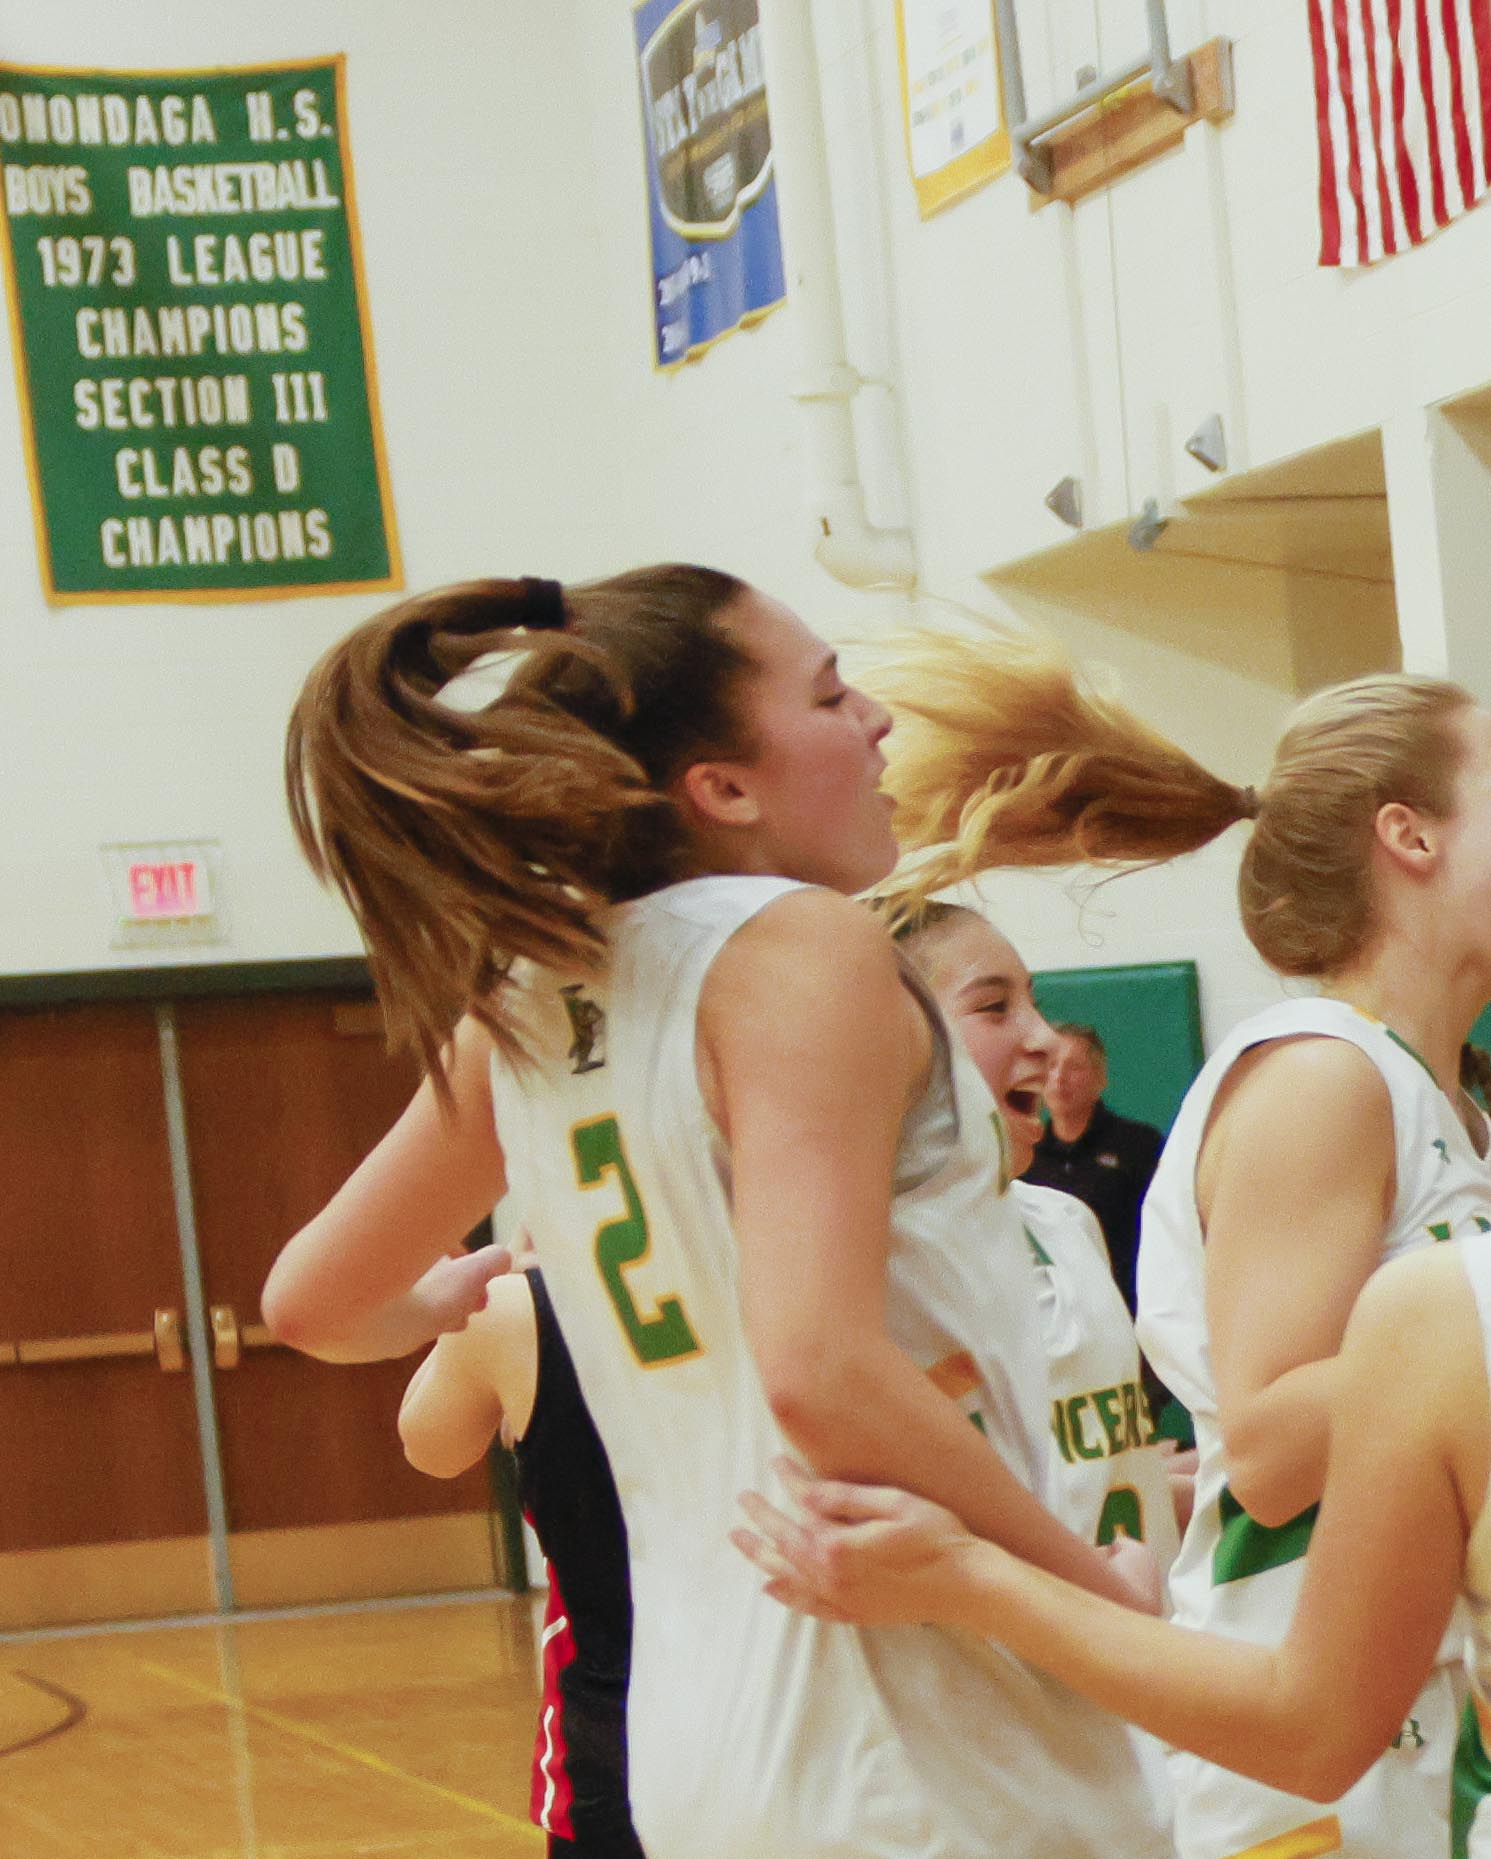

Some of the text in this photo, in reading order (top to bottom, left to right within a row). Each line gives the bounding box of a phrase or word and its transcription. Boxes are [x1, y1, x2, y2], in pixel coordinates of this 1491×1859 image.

[0, 89, 332, 146] ONONDAGA H.S.
[4, 158, 341, 217] BOYS BASKETBALL
[37, 229, 327, 286] 1973 LEAGUE
[75, 302, 310, 359] CHAMPIONS
[73, 371, 328, 431] SECTION III
[115, 443, 301, 499] CLASS D
[100, 508, 332, 568] CHAMPIONS
[129, 862, 196, 913] EXIT
[568, 1110, 706, 1371] 2
